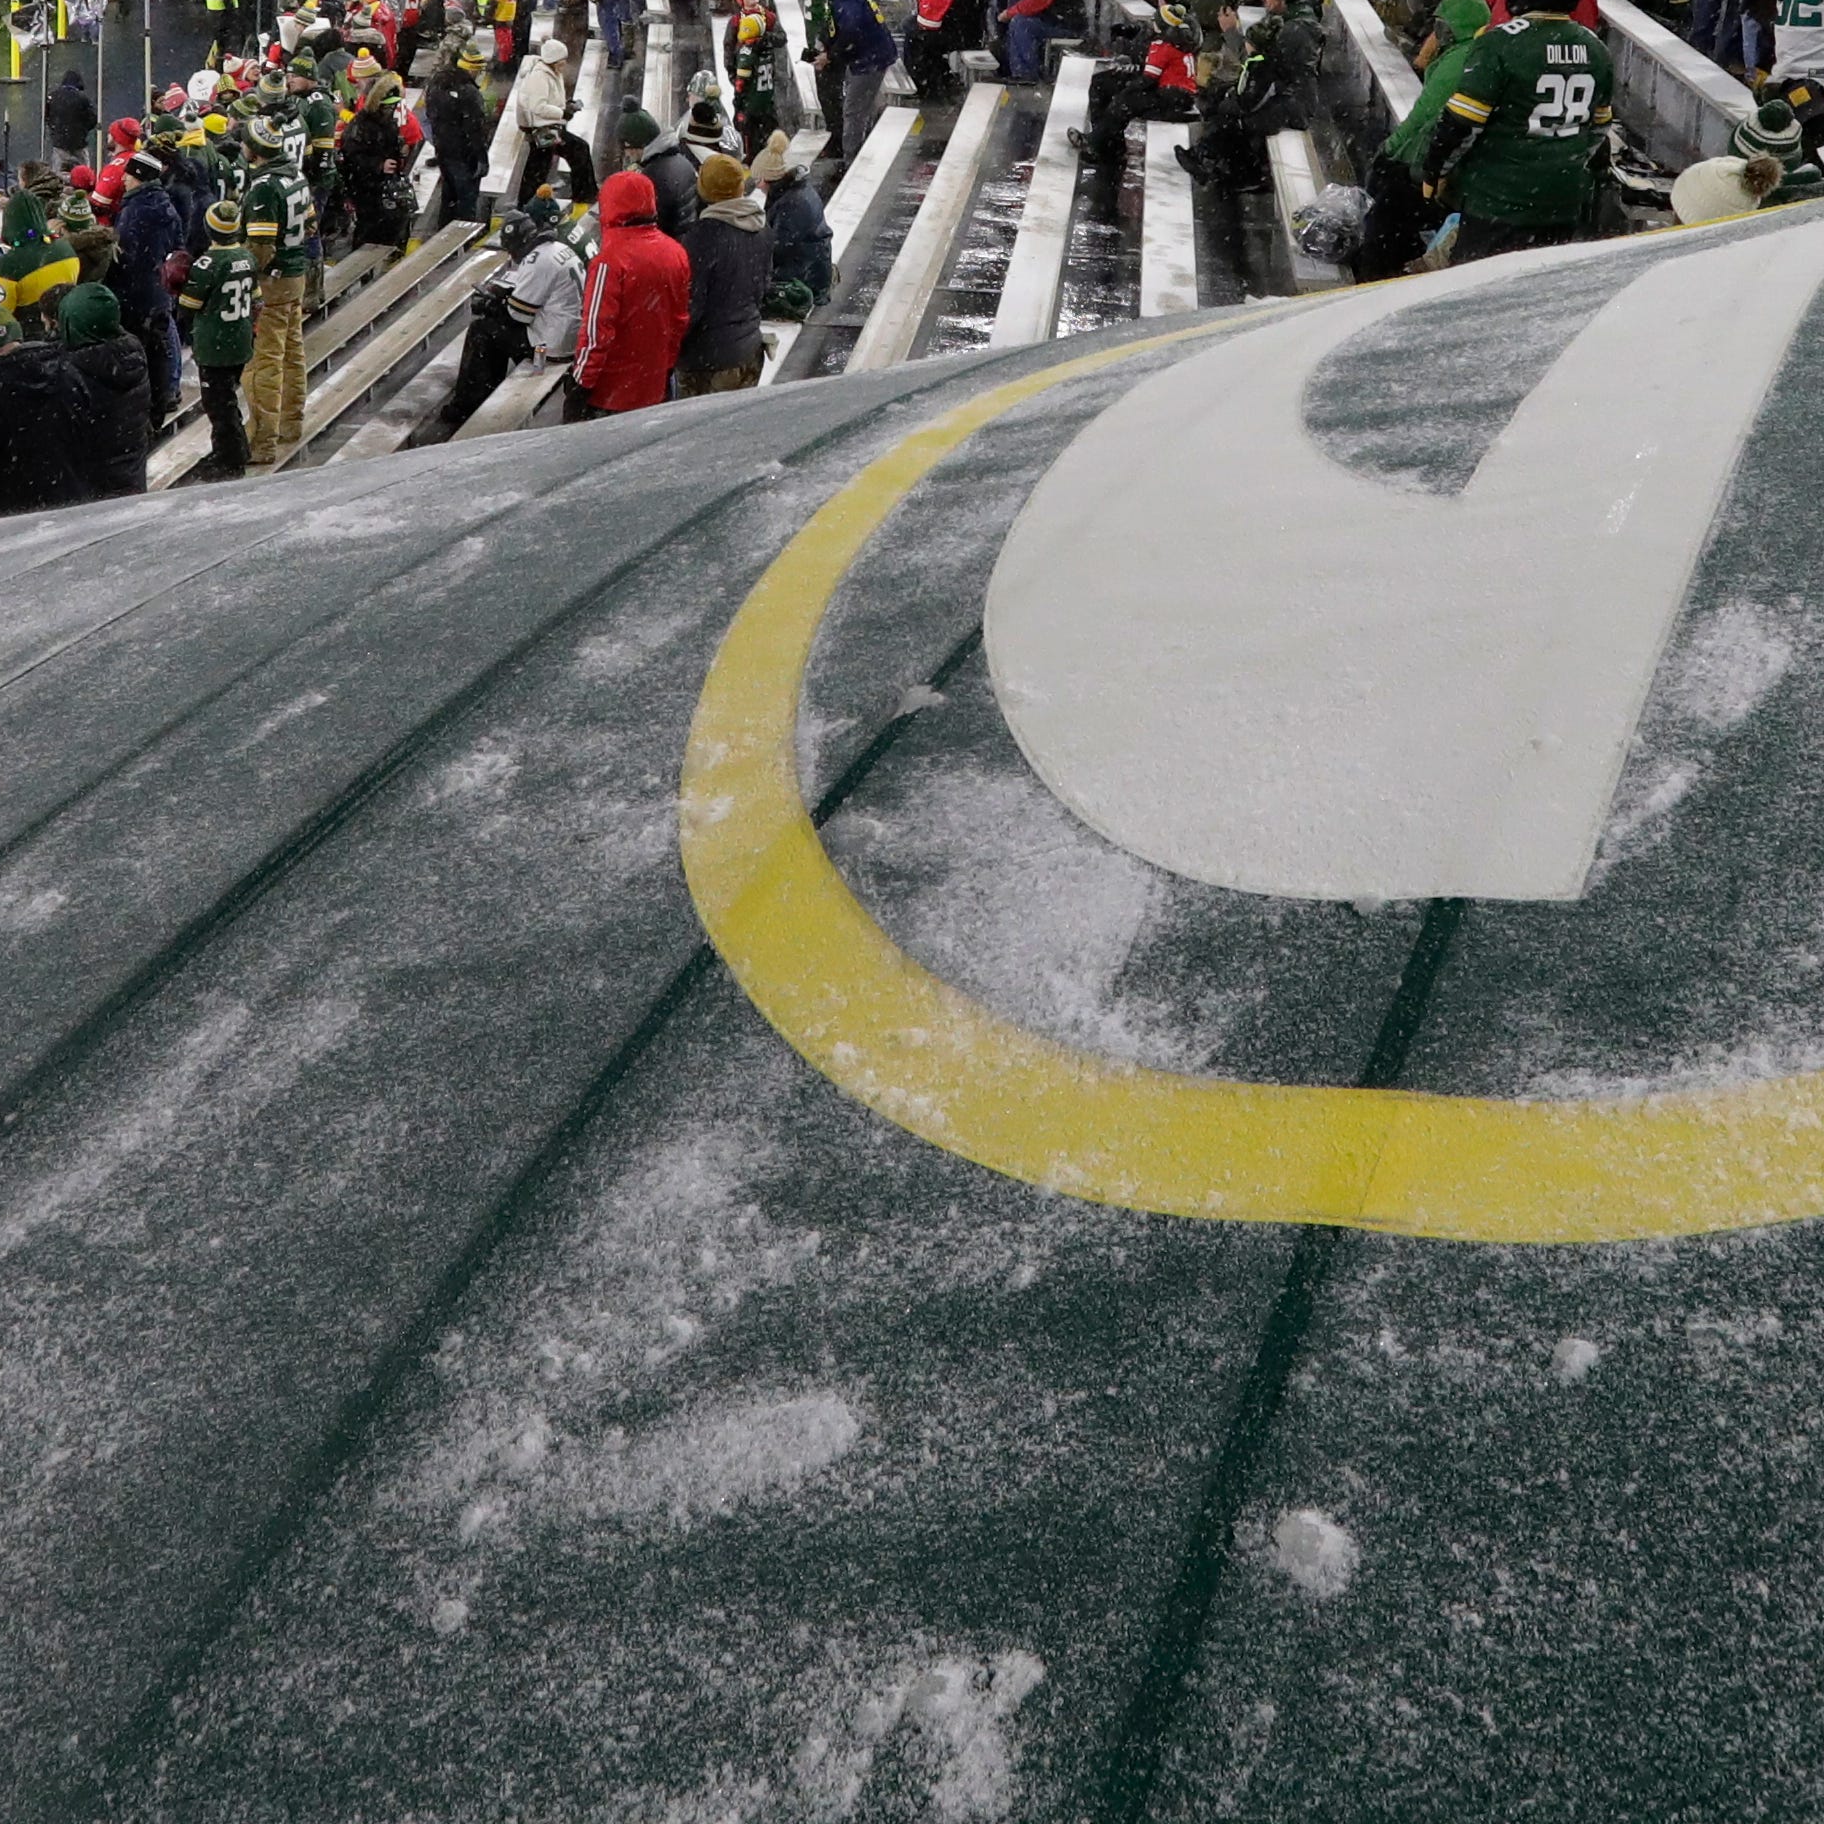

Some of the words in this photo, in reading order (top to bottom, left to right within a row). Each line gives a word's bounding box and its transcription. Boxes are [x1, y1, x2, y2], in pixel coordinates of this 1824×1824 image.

[1546, 44, 1587, 65] DILLON
[1528, 74, 1596, 137] 28
[219, 277, 254, 323] 33
